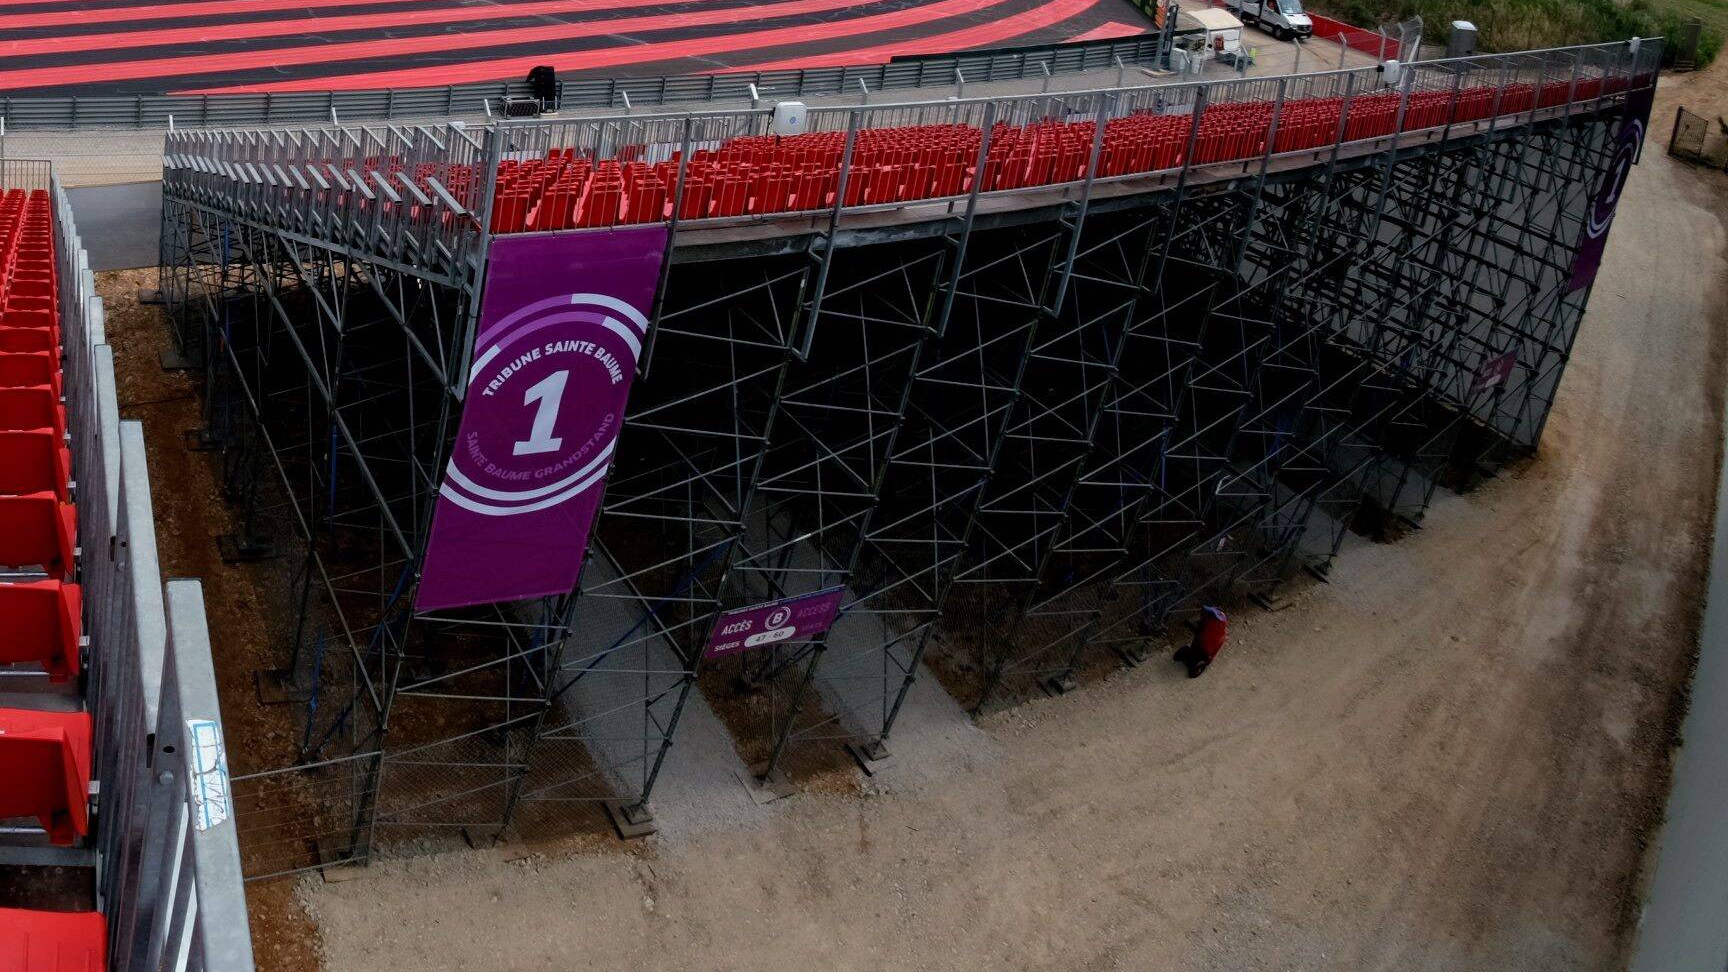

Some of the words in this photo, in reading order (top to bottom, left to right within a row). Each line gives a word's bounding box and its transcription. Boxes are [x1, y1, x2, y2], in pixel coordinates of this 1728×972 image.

[482, 347, 542, 397] TRIBUNE
[544, 340, 597, 356] SAINTE
[593, 347, 624, 386] BAUME
[513, 370, 570, 456] 1
[467, 431, 489, 467] SAINTE
[484, 463, 532, 481] BAUME
[534, 413, 615, 479] GRANDSTAND
[722, 620, 753, 635] ACCÈS
[772, 613, 783, 624] B
